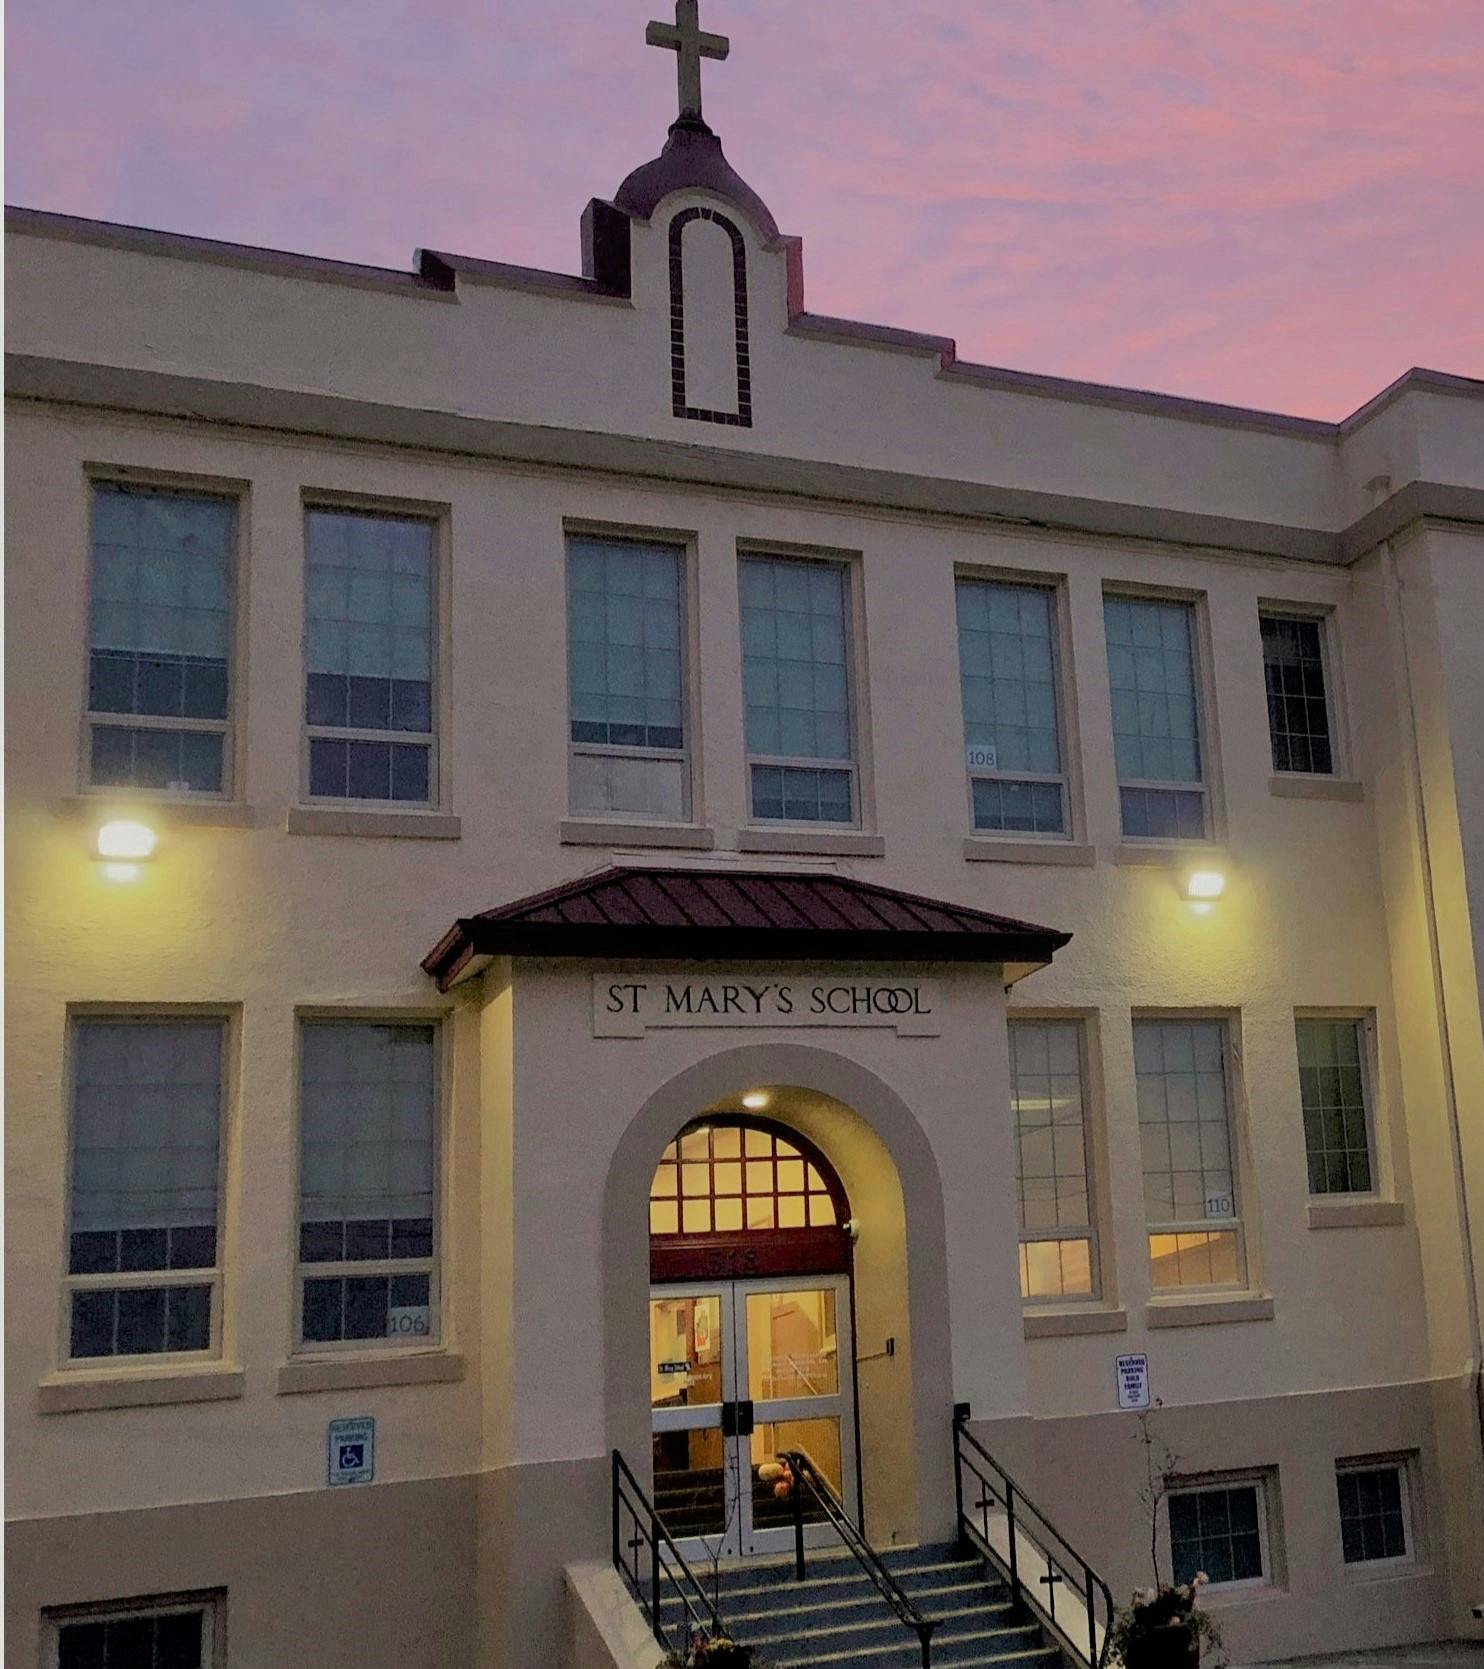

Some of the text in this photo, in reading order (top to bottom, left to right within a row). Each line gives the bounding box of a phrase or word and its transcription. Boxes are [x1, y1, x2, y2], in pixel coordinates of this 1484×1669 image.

[969, 751, 994, 766] 108
[606, 983, 932, 1014] ST MARY'S SCHOOL
[1207, 1198, 1230, 1213] 110
[391, 1314, 425, 1333] 106
